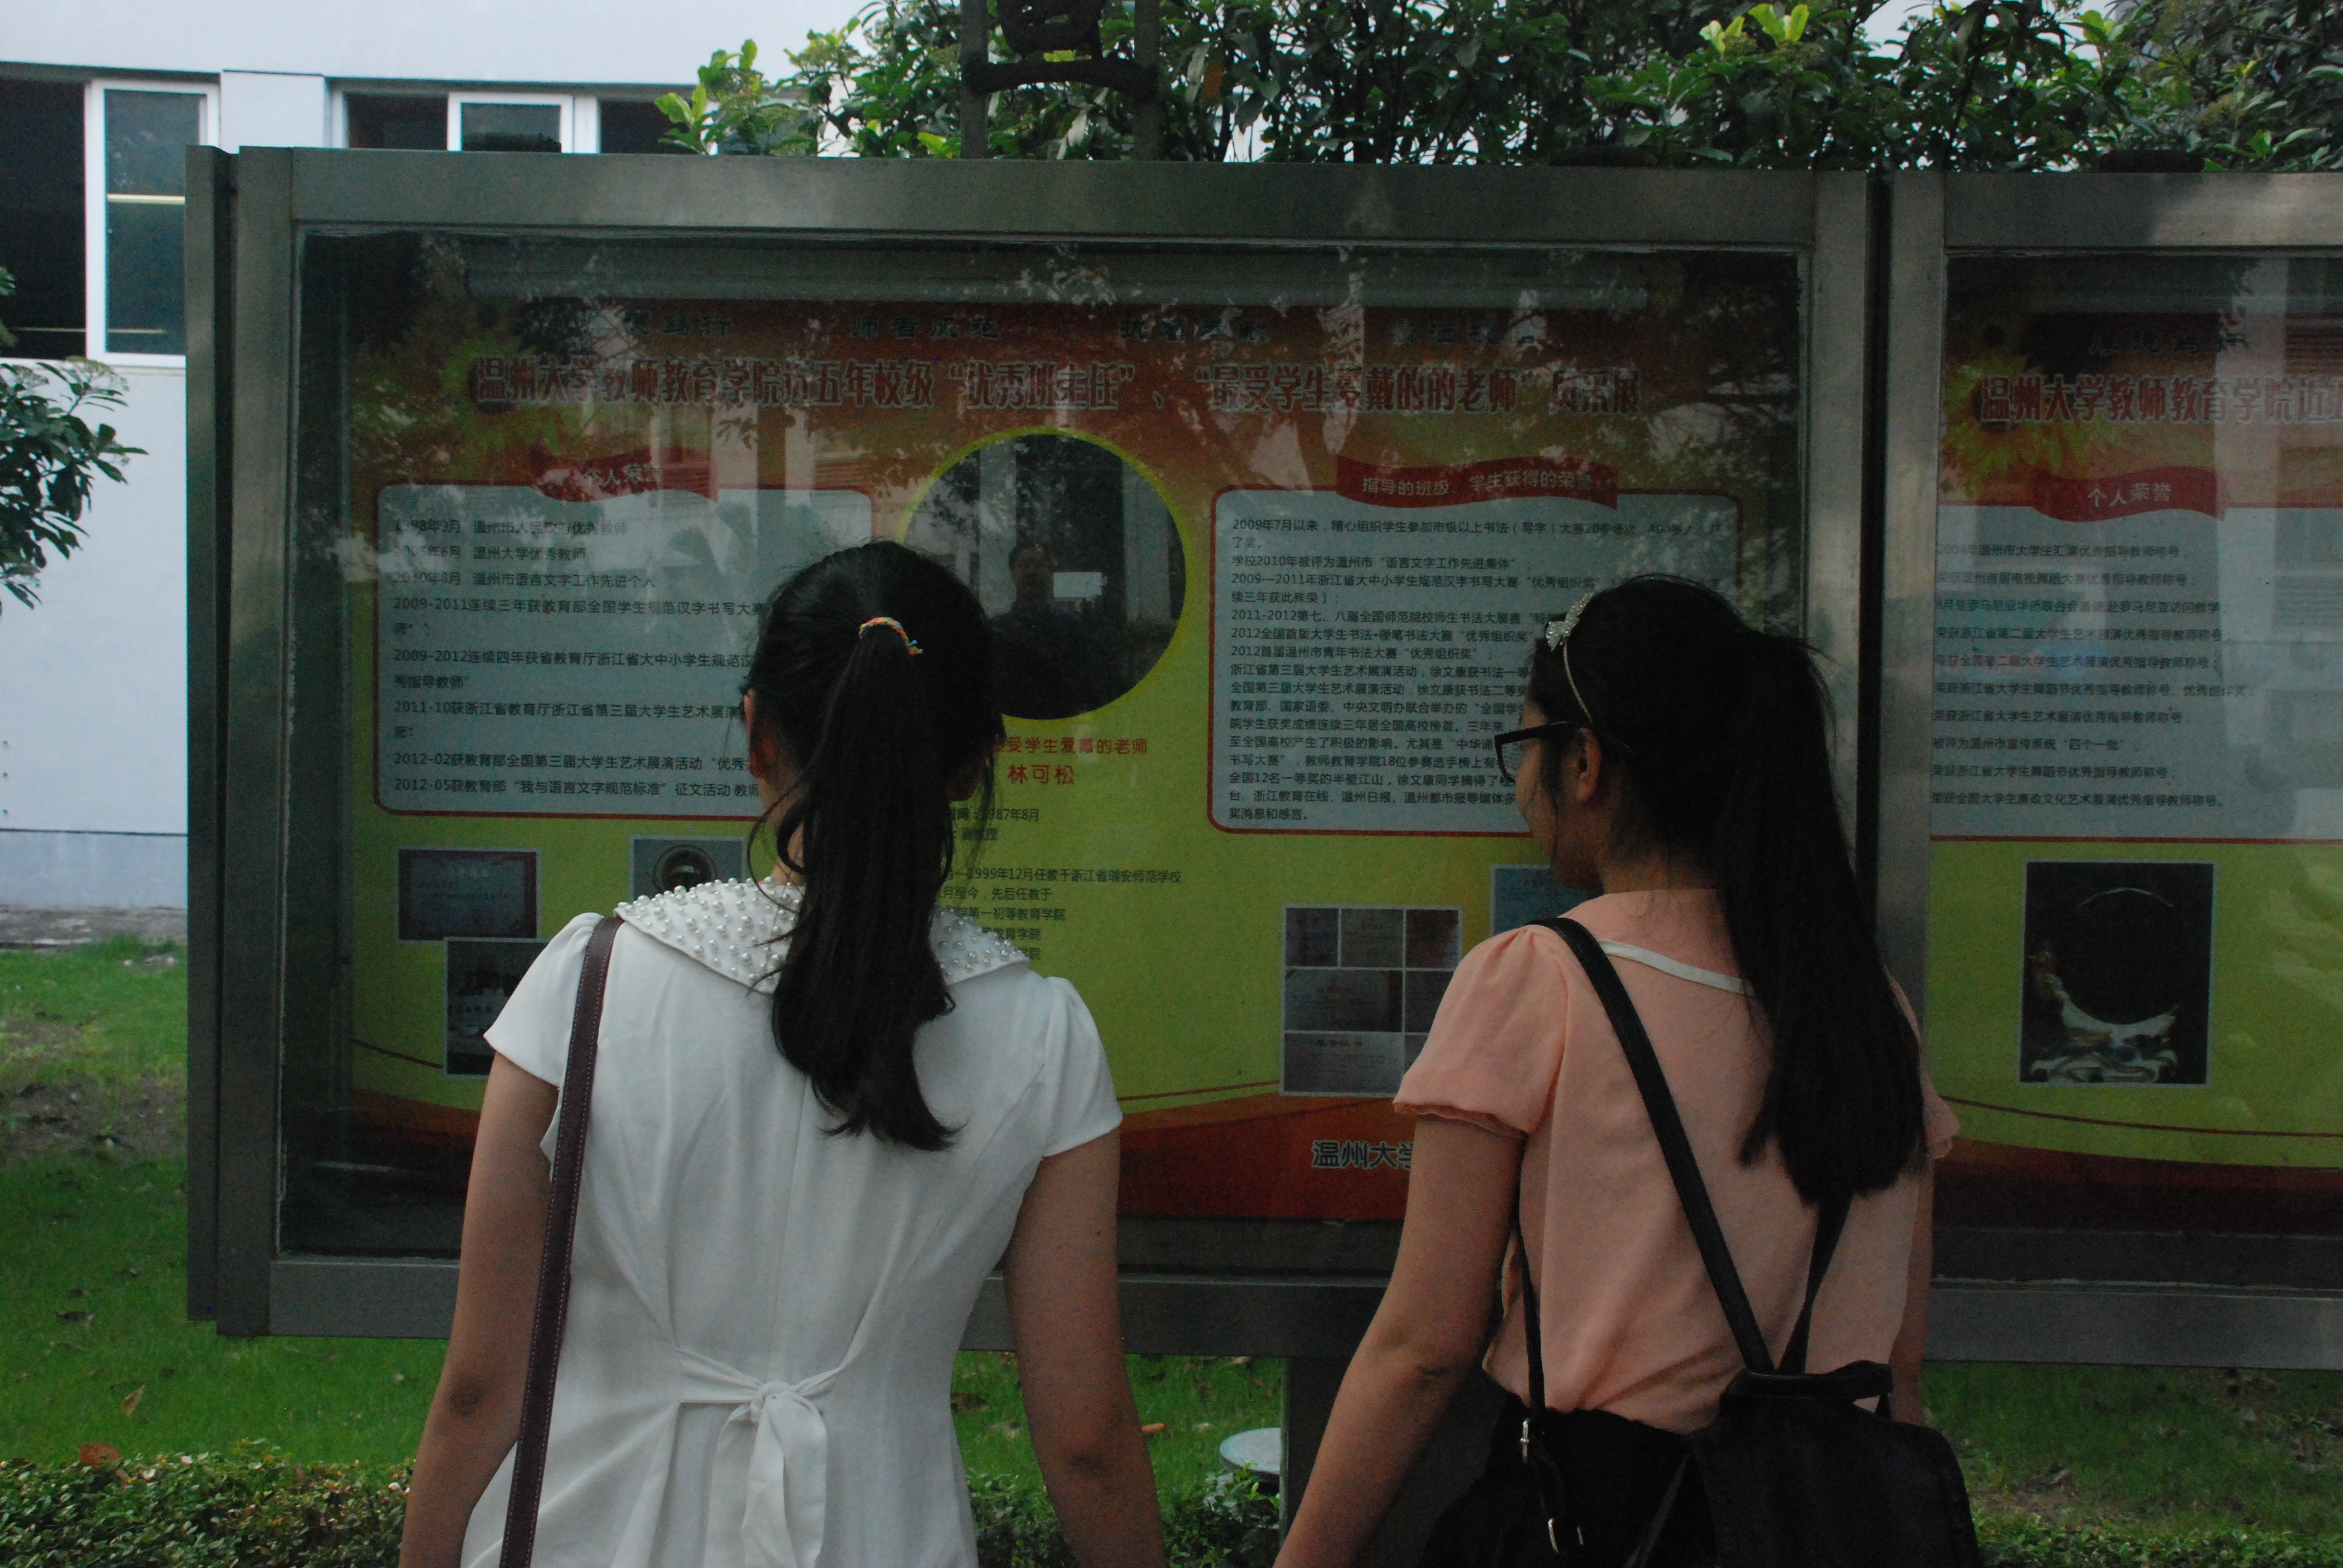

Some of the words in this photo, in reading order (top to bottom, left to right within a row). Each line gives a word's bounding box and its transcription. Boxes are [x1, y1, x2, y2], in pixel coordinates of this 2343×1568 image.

[2088, 483, 2172, 507] 个人荣誉
[395, 520, 460, 533] 198年9月
[473, 546, 585, 561] 温州大学优秀教师
[473, 573, 656, 588] 温州市语言文字工作先进个人
[994, 736, 1148, 755] 受学生爱戴的老师
[394, 753, 758, 771] 2012-02获教育部全国第三届大学生艺术展演活动“优秀
[1008, 764, 1075, 785] 林可松
